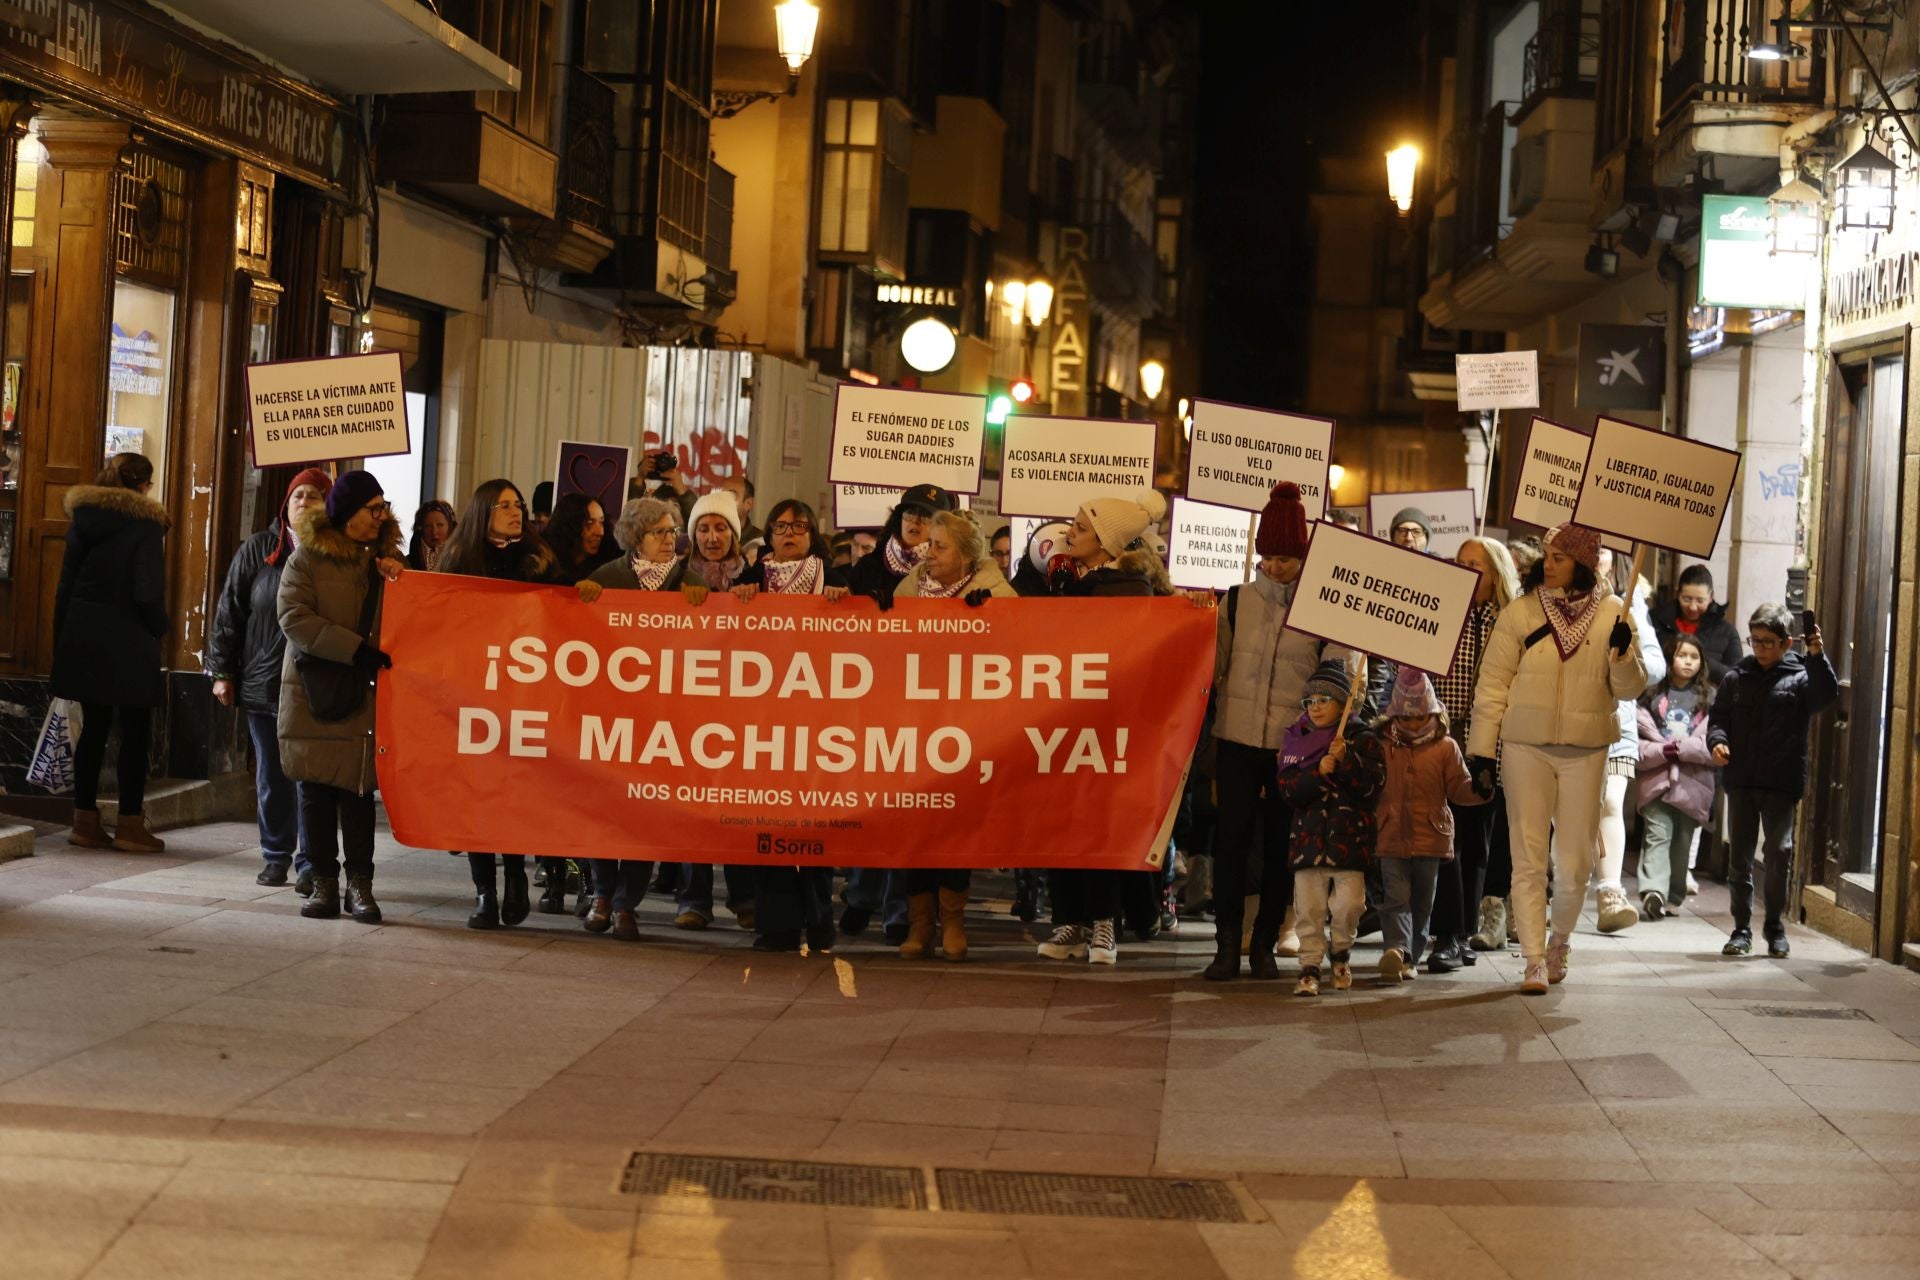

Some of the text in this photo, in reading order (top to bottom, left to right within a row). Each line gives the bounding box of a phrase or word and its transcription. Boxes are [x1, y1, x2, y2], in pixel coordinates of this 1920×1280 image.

[219, 75, 326, 166] ARTES GRÁFICAS
[255, 382, 396, 405] HACERSE LA VÍCTIMA ANTE
[264, 400, 394, 423] ELLA PARA SER CUIDADO
[852, 411, 970, 432] EL FENÓMENO DE LOS
[267, 419, 395, 442] ES VIOLENCIA MACHISTA
[866, 430, 954, 448] SUGAR DADDIES
[843, 445, 975, 467] ES VIOLENCIA MACHISTA
[1196, 430, 1324, 462] EL USO OBLIGATORIO DEL
[1008, 450, 1150, 469] ACOSARLA SEXUALMENTE
[1247, 456, 1272, 471] VELO
[1533, 449, 1581, 473] MINIMIZAR
[1011, 468, 1145, 486] ES VIOLENCIA MACHISTA
[1198, 466, 1210, 478] ES
[1213, 469, 1265, 488] VIOLENCIA
[1549, 473, 1566, 487] DEL
[1606, 458, 1715, 497] LIBERTAD, IGUALDAD
[843, 485, 855, 496] ES
[1525, 484, 1536, 497] ES
[1595, 475, 1716, 518] Y JUSTICIA PARA TODAS
[1180, 524, 1191, 533] LA
[1194, 525, 1237, 538] RELIGIÓN
[1432, 526, 1469, 534] MACHISTA
[1188, 540, 1212, 551] PARA
[1215, 543, 1232, 553] LAS
[1177, 555, 1187, 565] ES
[1191, 556, 1238, 569] VIOLENCIA
[1332, 565, 1440, 611] MIS DERECHOS
[1319, 586, 1439, 636] NO SE NEGOCIAN
[608, 612, 991, 634] EN SORIA Y EN CADA RINCÓN DEL MUNDO:
[485, 636, 1109, 700] ¡SOCIEDAD LIBRE
[457, 707, 1129, 784] DE MACHISMO, YA!
[627, 783, 956, 809] NOS QUEREMOS VIVAS Y LIBRES
[719, 814, 863, 831] Consejo Municipal de las Mujeres
[774, 838, 824, 855] Soria
